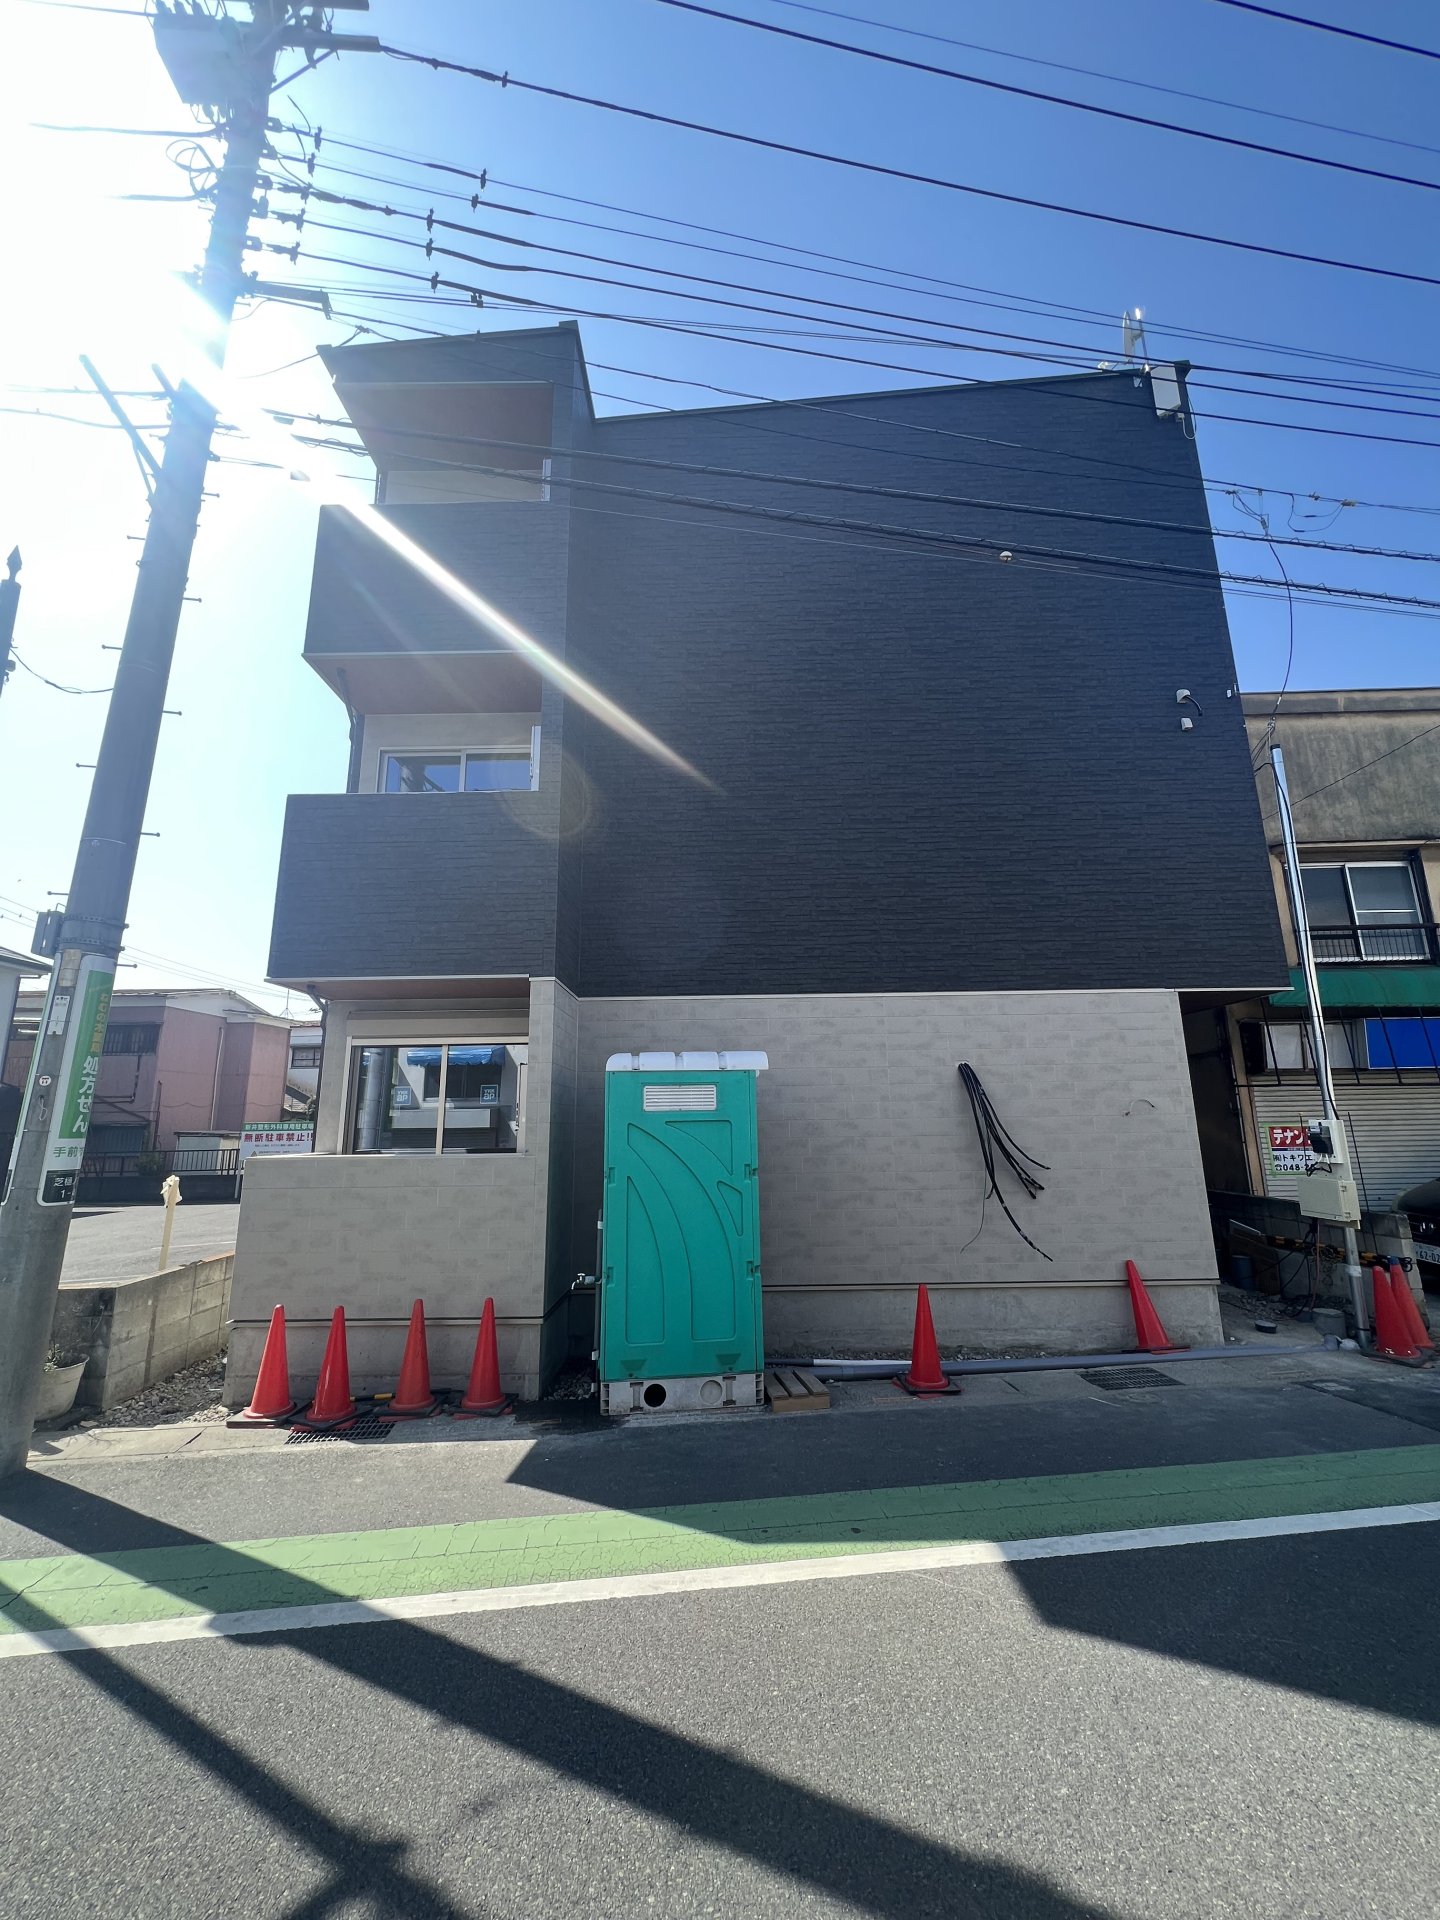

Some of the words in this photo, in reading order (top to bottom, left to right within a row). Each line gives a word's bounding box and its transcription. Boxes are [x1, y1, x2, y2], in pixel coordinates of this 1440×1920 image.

[72, 1056, 99, 1133] 処方せん
[1273, 1129, 1311, 1144] テナン
